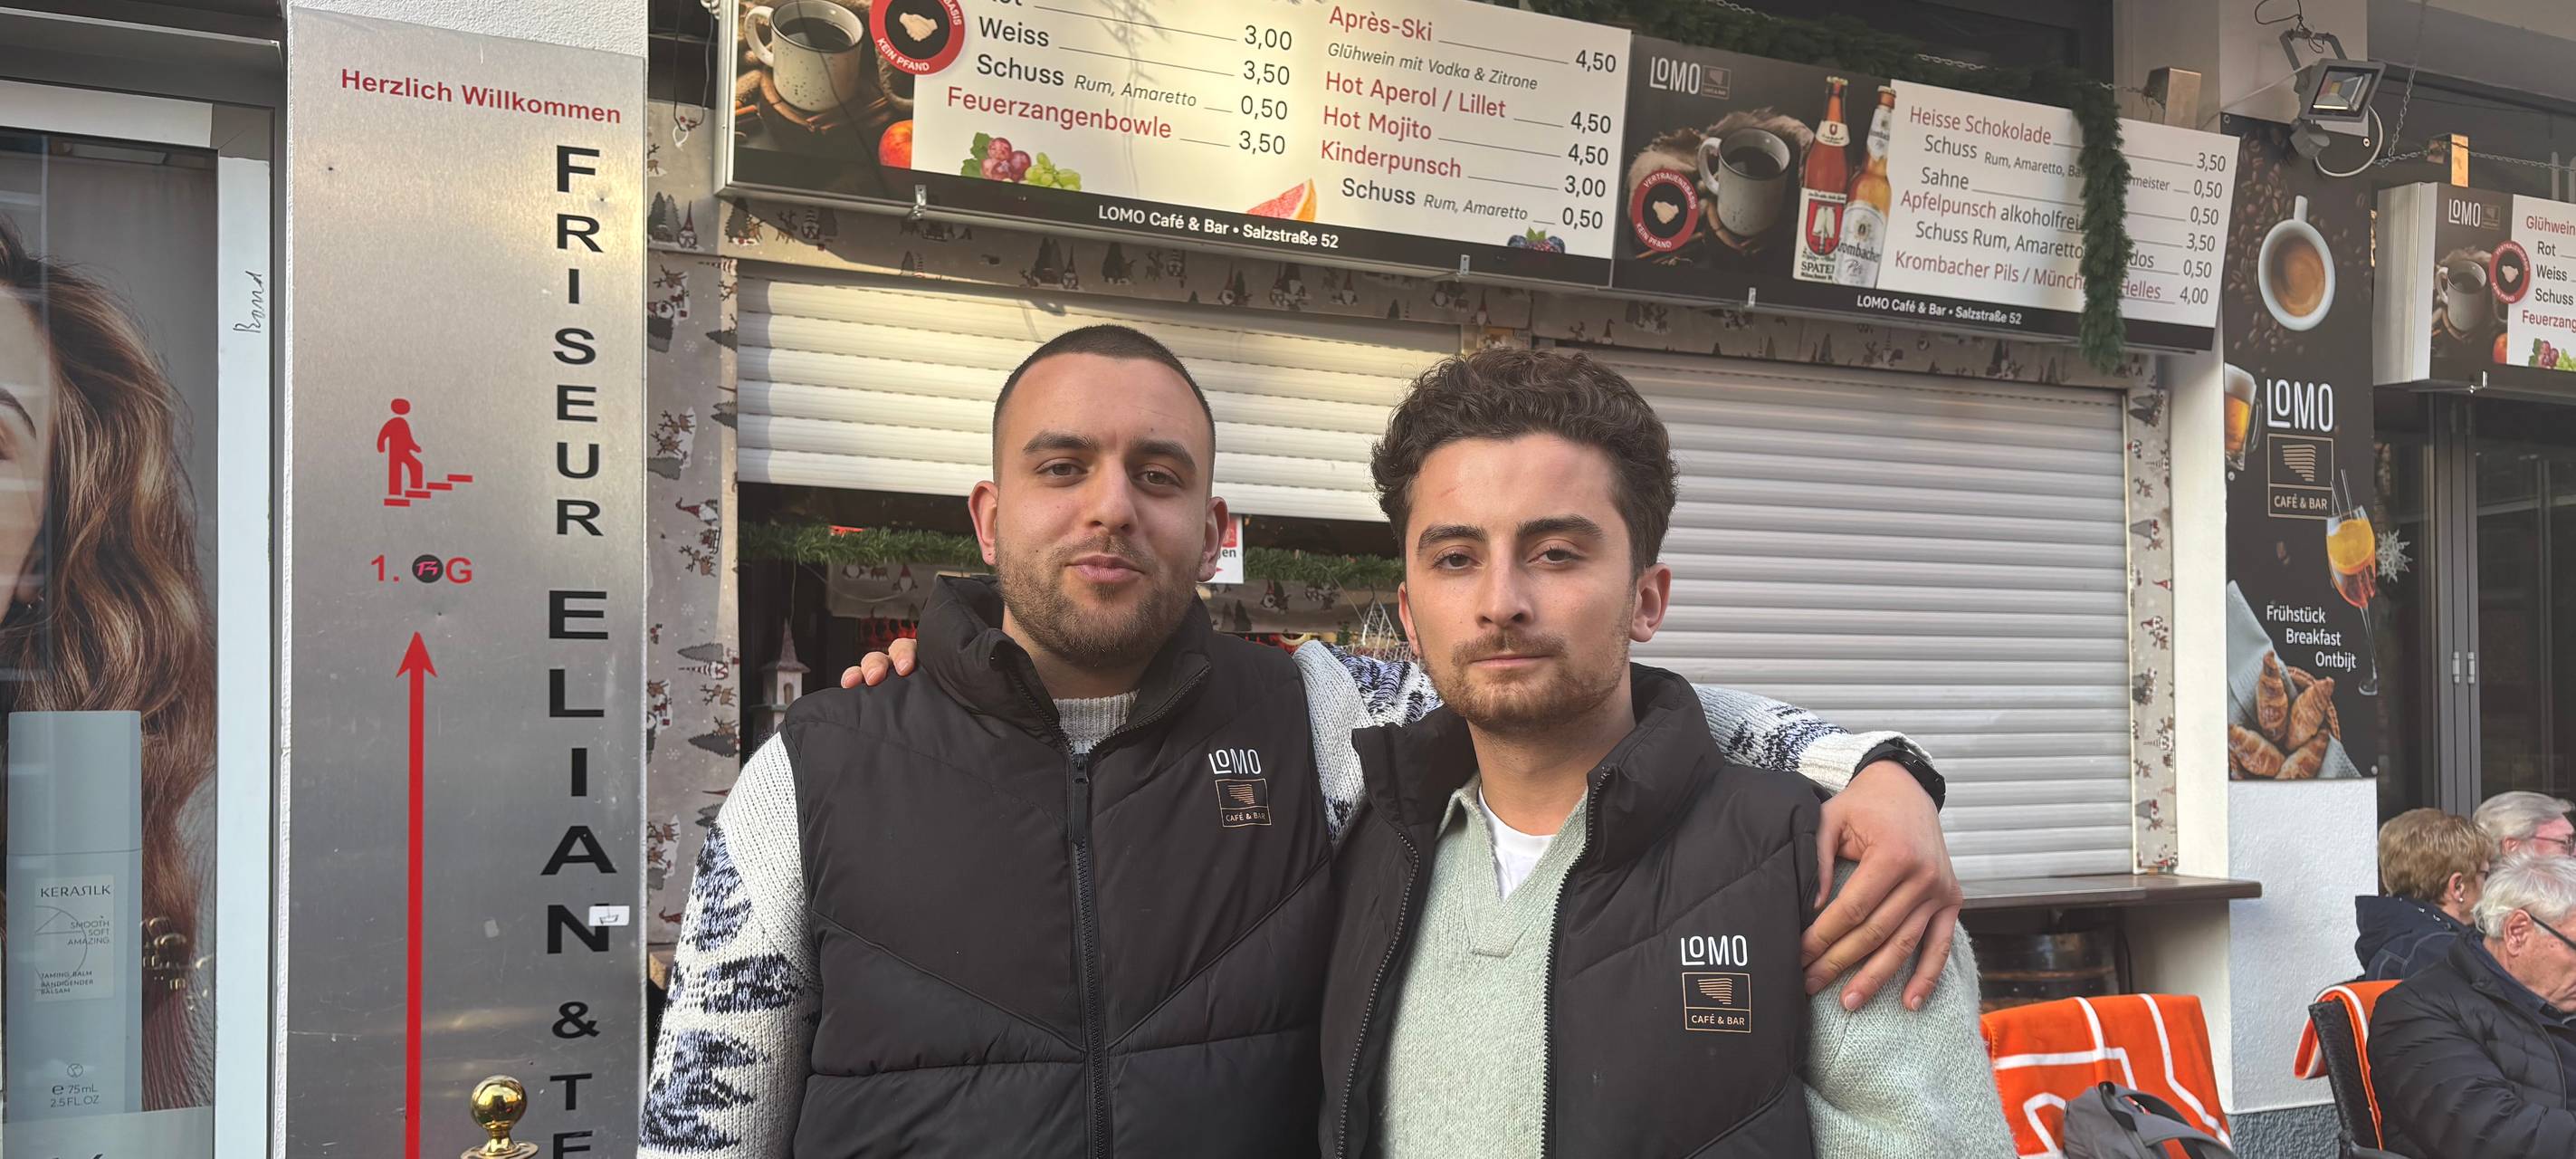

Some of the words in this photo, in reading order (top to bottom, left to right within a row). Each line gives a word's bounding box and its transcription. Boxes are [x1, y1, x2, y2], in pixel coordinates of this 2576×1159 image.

[876, 37, 896, 60] KEIN
[896, 55, 930, 72] PFAND
[978, 15, 1050, 47] Weiss
[1243, 60, 1290, 85] 3,50
[1244, 24, 1293, 51] 3,00
[1329, 5, 1433, 42] Après-Ski
[1575, 50, 1617, 72] 4,50
[977, 53, 1064, 86] Schuss
[1073, 74, 1115, 97] Rum,
[1121, 82, 1197, 107] Amaretto
[1241, 95, 1288, 120] 0,50
[1398, 56, 1424, 72] mit
[1428, 59, 1470, 79] Vodka
[1474, 67, 1485, 81] &
[1488, 69, 1538, 91] Zitrone
[1649, 56, 1701, 95] LOMO
[341, 68, 453, 102] Herzlich
[461, 84, 621, 124] Willkommen
[1326, 71, 1363, 96] Hot
[1369, 79, 1436, 107] Aperol
[1442, 90, 1453, 112] /
[1458, 91, 1507, 118] Lillet
[1570, 111, 1611, 134] 4,50
[948, 86, 1172, 139] Feuerzangenbowle
[1238, 130, 1286, 155] 3,50
[1323, 105, 1360, 129] Hot
[1369, 112, 1432, 142] Mojito
[1568, 143, 1608, 166] 4,50
[1910, 105, 1961, 130] Heisse
[1964, 114, 2052, 145] Schokolade
[2196, 152, 2227, 172] 3,50
[1321, 139, 1462, 177] Kinderpunsch
[1564, 175, 1606, 198] 3,00
[1924, 134, 1978, 159] Schuss
[1984, 151, 2011, 169] Rum,
[2013, 157, 2066, 177] Amaretto,
[2193, 179, 2223, 198] 0,50
[1341, 177, 1416, 206] Schuss
[1424, 194, 1459, 214] Rum,
[1463, 200, 1528, 221] Amaretto
[1561, 207, 1603, 229] 0,50
[1921, 167, 1970, 190] Sahne
[2190, 206, 2219, 225] 0,50
[2447, 198, 2481, 227] LOMO
[1098, 205, 1146, 224] LOMO
[1149, 211, 1184, 229] Café
[1188, 217, 1200, 232] &
[1204, 219, 1228, 235] Bar
[1243, 225, 1318, 246] Salzstraße
[1321, 234, 1339, 249] 52
[1901, 189, 1996, 219] Apfelpunsch
[2186, 233, 2216, 252] 3,50
[2526, 216, 2576, 236] Glühwein
[1915, 221, 1968, 244] Schuss
[1972, 228, 2011, 252] Rum,
[2183, 259, 2212, 279] 0,50
[2537, 241, 2556, 257] Rot
[1895, 250, 1989, 278] Krombacher
[1994, 263, 2019, 283] Pils
[2022, 267, 2030, 283] /
[2033, 268, 2085, 291] Münch
[2180, 286, 2209, 305] 4,00
[2536, 263, 2568, 282] Weiss
[1856, 294, 1889, 310] LOMO
[1892, 299, 1916, 313] Café
[1918, 302, 1926, 314] &
[1929, 302, 1946, 316] Bar
[1955, 306, 2007, 323] Salzstraße
[2008, 312, 2022, 325] 52
[2535, 288, 2574, 306] Schuss
[553, 145, 604, 536] FRISEUR
[2266, 378, 2334, 433] LOMO
[2274, 493, 2297, 510] CAFÉ
[2299, 496, 2307, 510] &
[2308, 496, 2328, 511] BAR
[371, 554, 400, 583] 1.
[2266, 604, 2326, 625] Frühstück
[2285, 627, 2342, 647] Breakfast
[2315, 650, 2356, 672] Ontbijt
[539, 590, 617, 954] ELIAN
[1208, 748, 1262, 775] LOMO
[1226, 811, 1245, 822] CAFÉ
[1253, 811, 1265, 819] BAR
[41, 885, 110, 898] KERASILK
[67, 937, 110, 945] AMAZING
[71, 920, 110, 929] SMOOTH
[88, 928, 110, 936] SOFT
[1681, 934, 1748, 966] LOMO
[551, 1001, 601, 1039] &
[1691, 1014, 1715, 1024] CAFÉ
[1717, 1016, 1724, 1025] &
[1727, 1017, 1745, 1026] BAR
